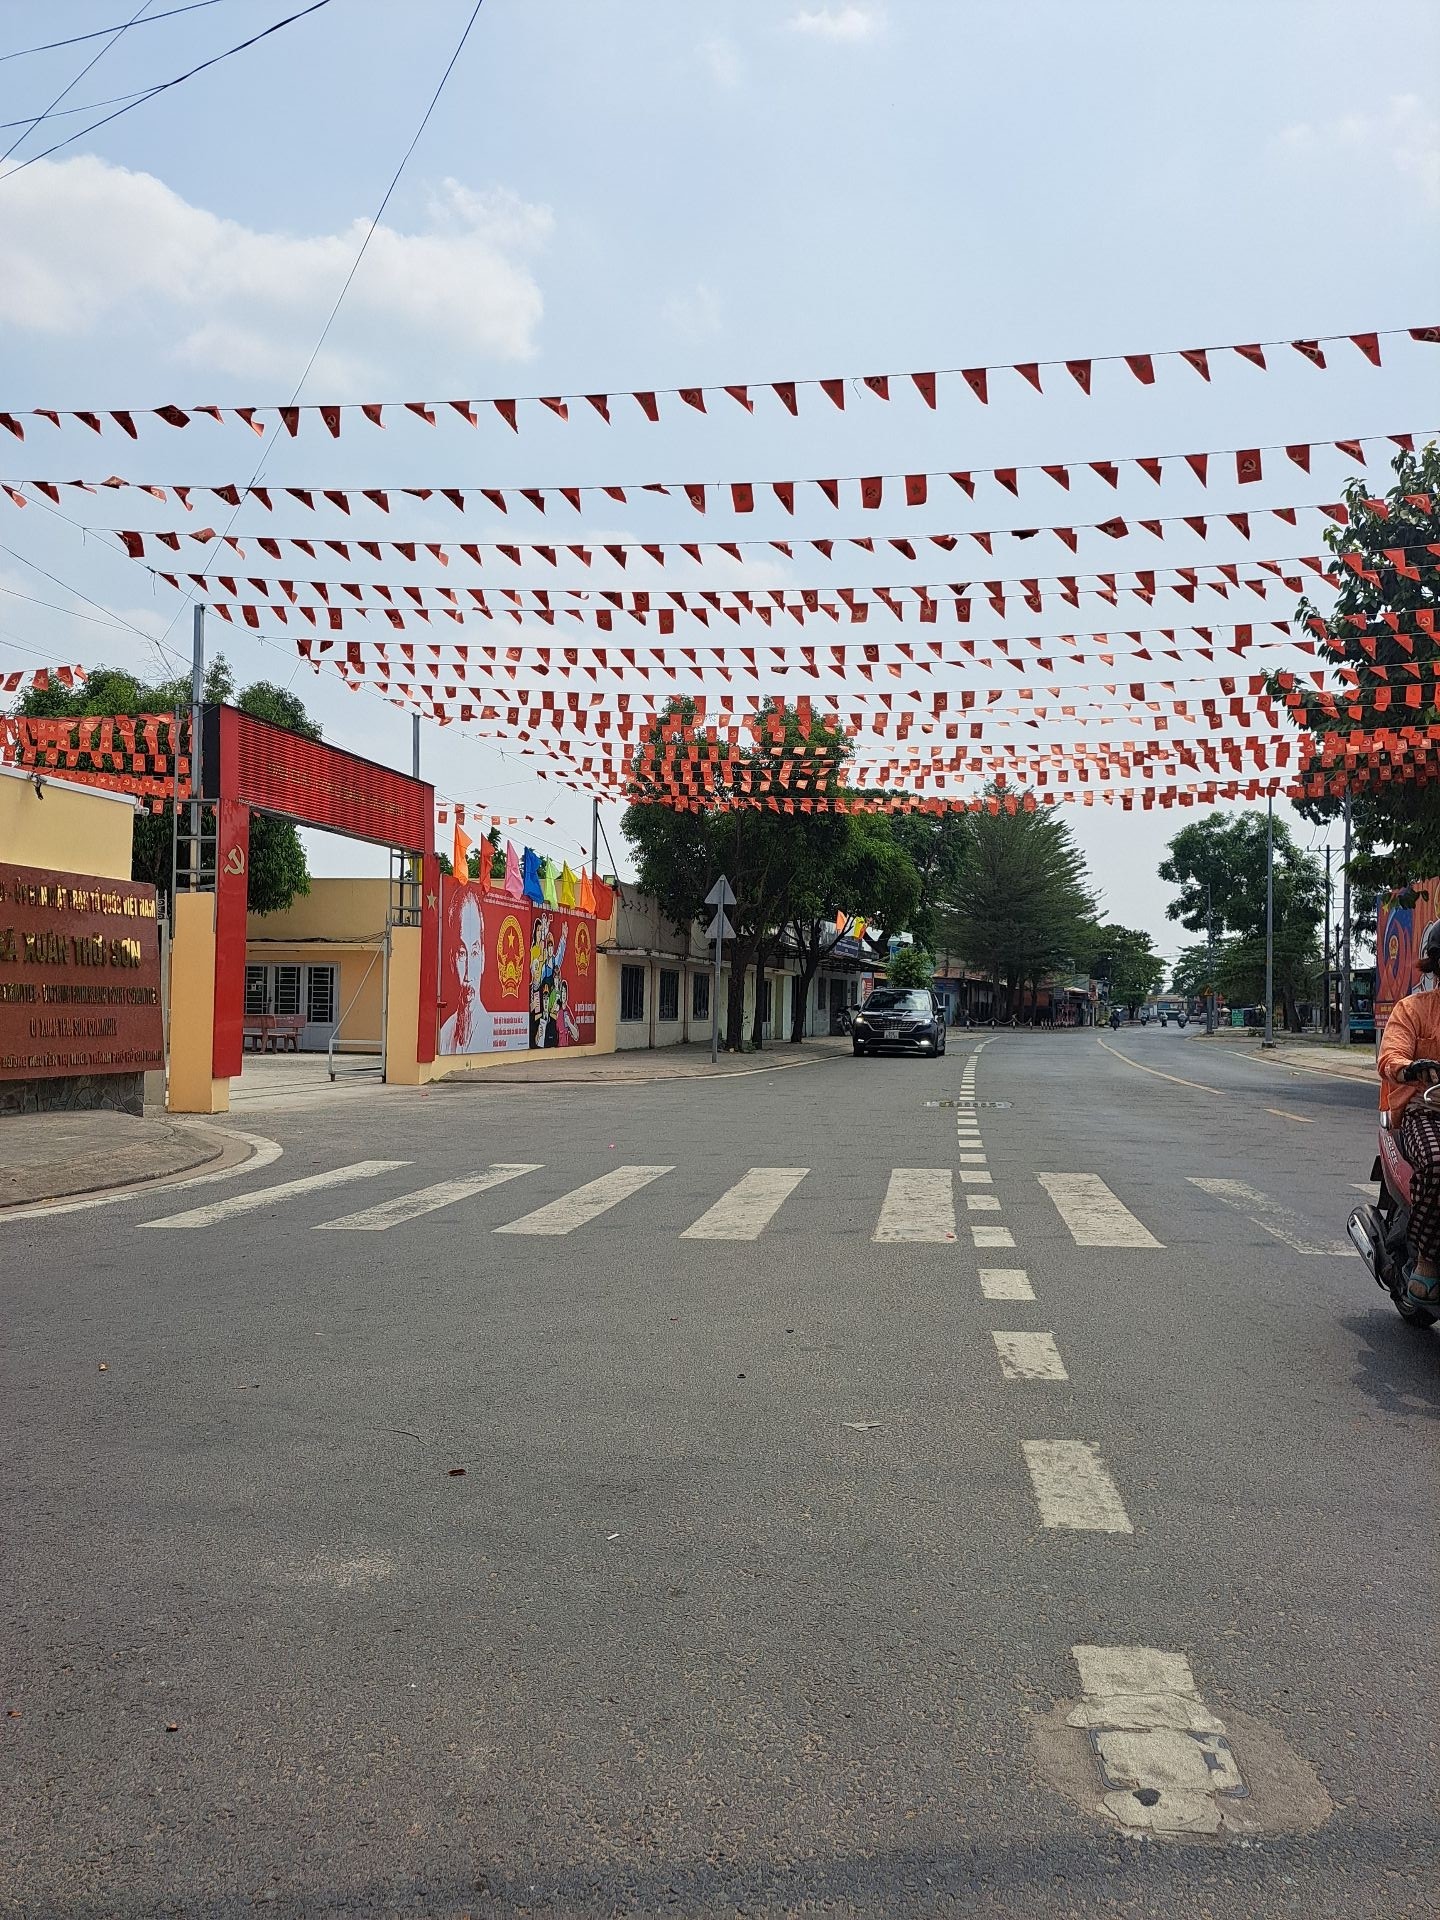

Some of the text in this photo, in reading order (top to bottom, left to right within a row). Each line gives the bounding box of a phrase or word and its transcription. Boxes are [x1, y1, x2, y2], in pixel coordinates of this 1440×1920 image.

[101, 889, 122, 915] QUỐC
[122, 893, 139, 919] VIỆT
[139, 898, 156, 918] NAM
[23, 929, 68, 964] XUÂN
[111, 937, 142, 968] SƠN
